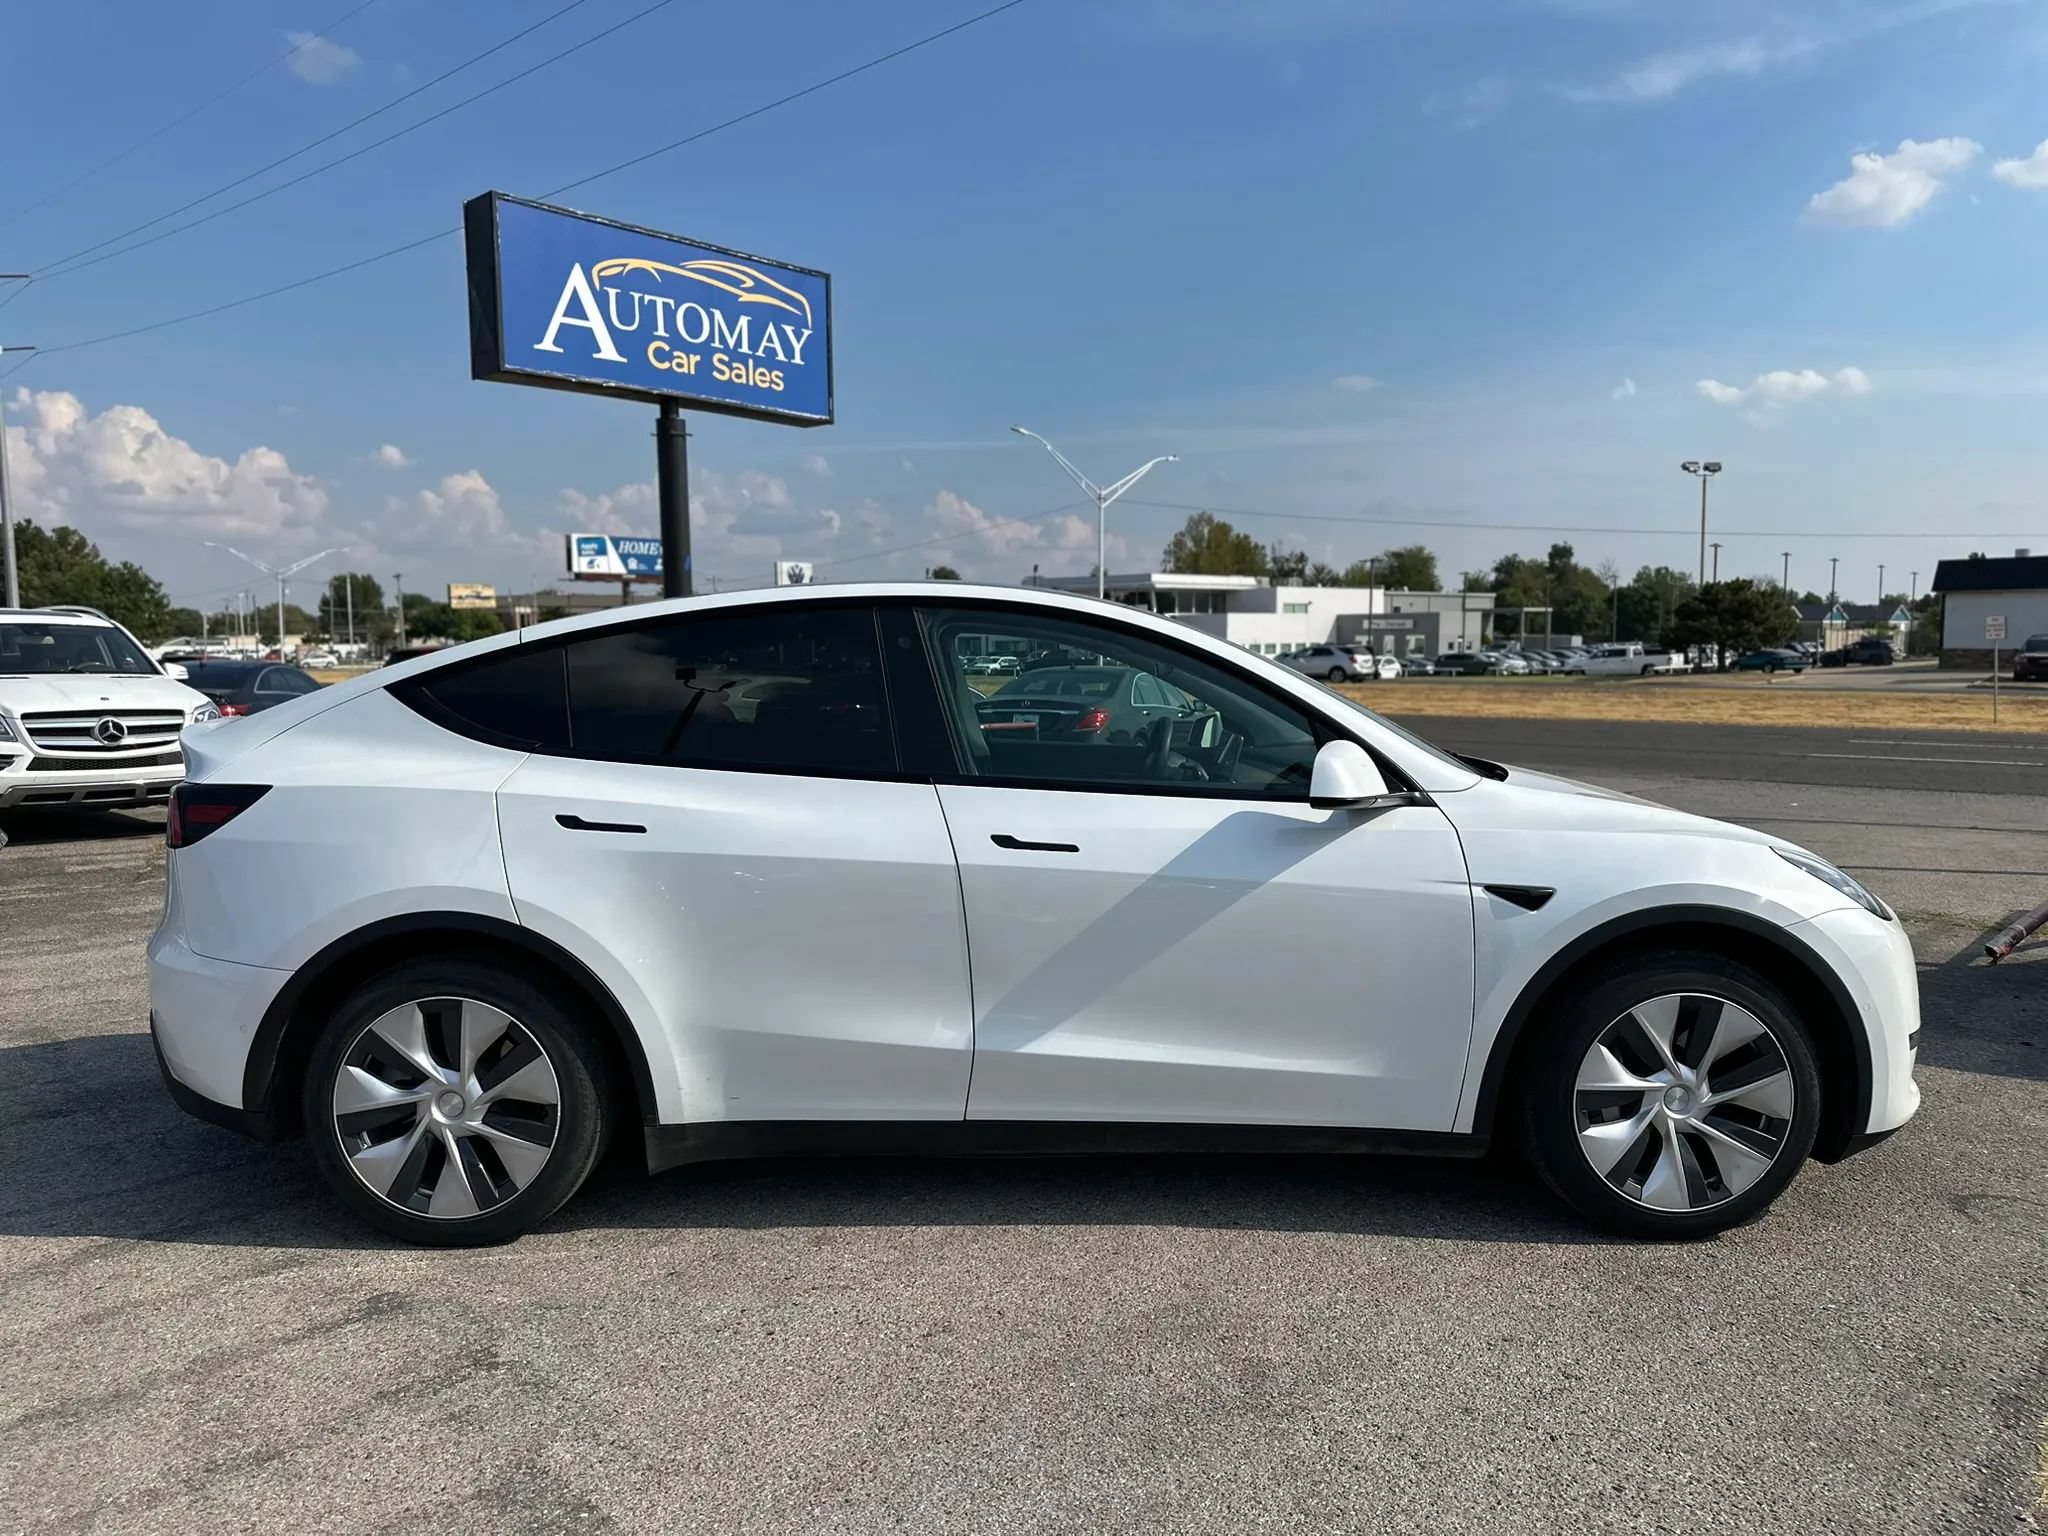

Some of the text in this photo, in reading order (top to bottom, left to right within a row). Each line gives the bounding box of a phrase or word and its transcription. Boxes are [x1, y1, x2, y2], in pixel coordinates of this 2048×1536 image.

[533, 262, 813, 365] AUTOMAY
[647, 340, 785, 392] Car Sales
[618, 540, 663, 556] HOME
